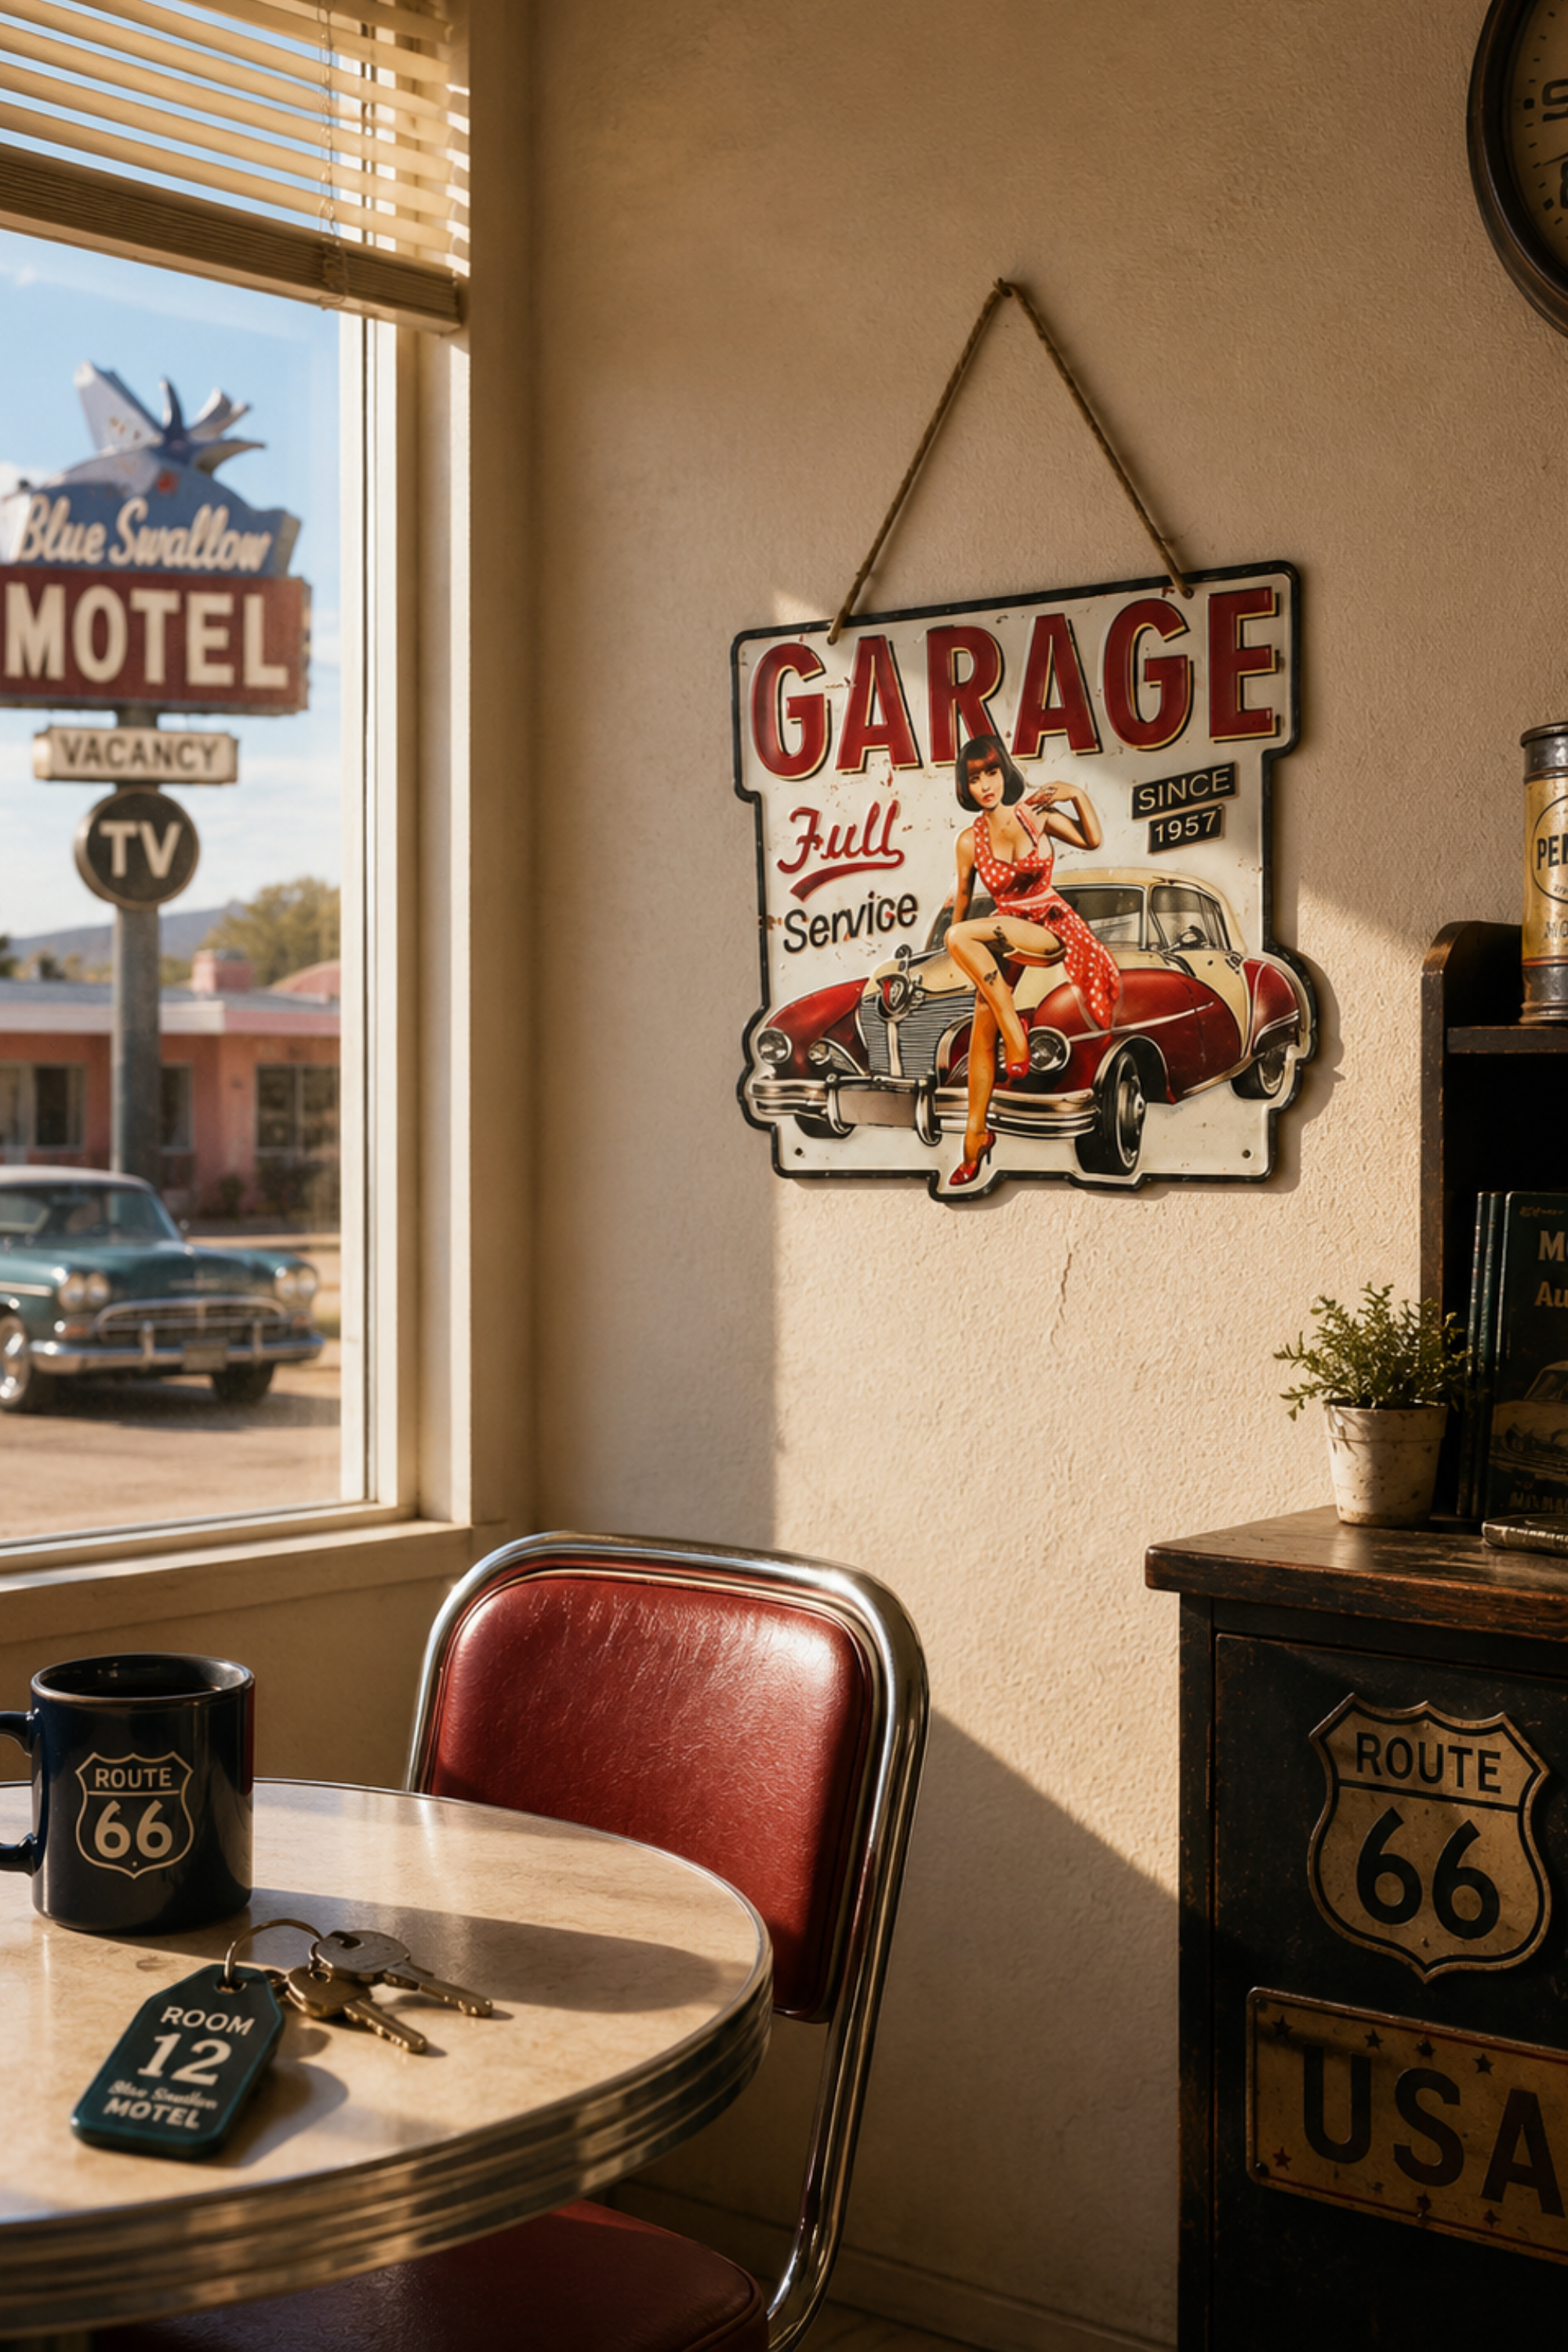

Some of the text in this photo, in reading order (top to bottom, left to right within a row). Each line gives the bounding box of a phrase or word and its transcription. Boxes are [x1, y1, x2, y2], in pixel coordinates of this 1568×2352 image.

[19, 496, 273, 572] Blue Swallow
[5, 582, 289, 688] MOTEL
[751, 586, 1281, 781] GARAGE
[59, 734, 220, 771] VACANCY
[1138, 767, 1230, 811] SINCE
[99, 819, 183, 879] TV
[777, 799, 905, 875] Full
[1155, 810, 1217, 844] 1957
[783, 891, 918, 954] Service
[1537, 1229, 1568, 1262] M
[94, 1766, 173, 1789] ROUTE
[1355, 1731, 1502, 1795] ROUTE
[93, 1799, 173, 1860] 66
[1356, 1806, 1501, 1940] 66
[160, 2005, 256, 2036] ROOM
[136, 2033, 232, 2087] 12
[102, 2096, 201, 2131] MOTEL
[1302, 2043, 1568, 2219] USA
